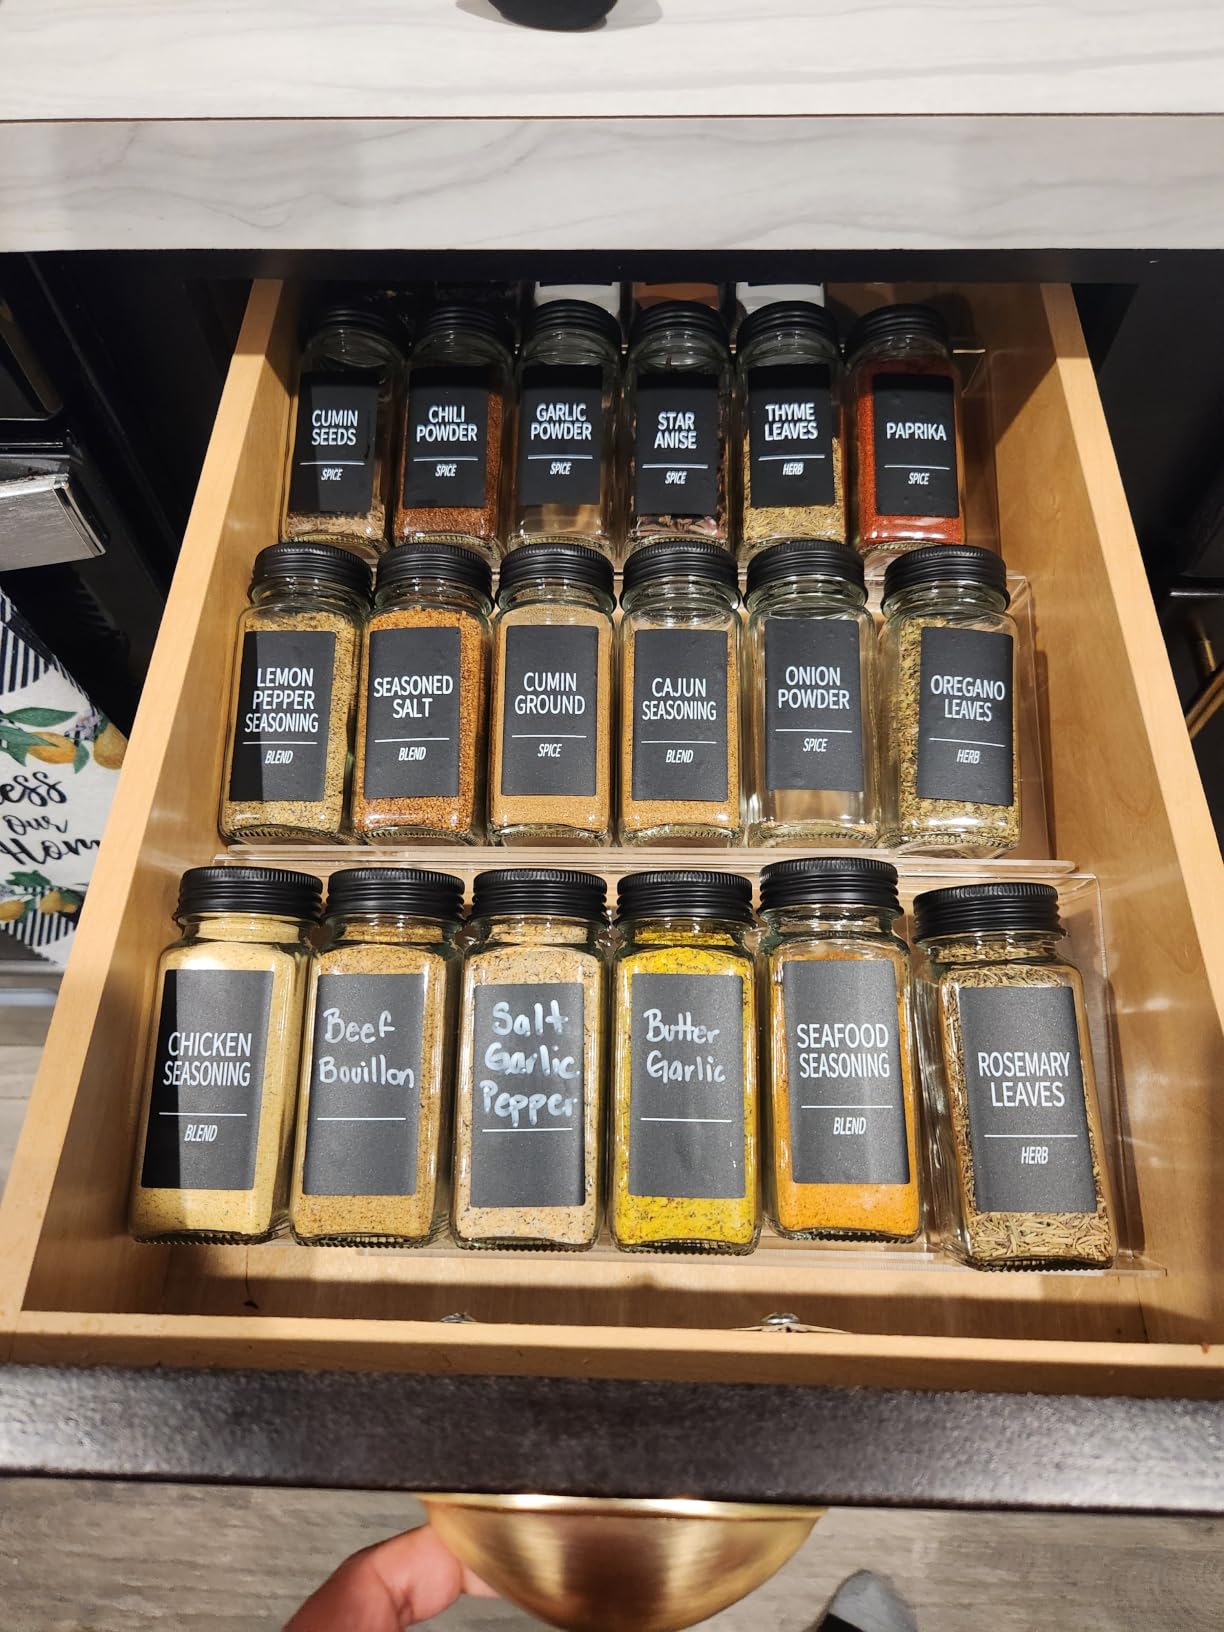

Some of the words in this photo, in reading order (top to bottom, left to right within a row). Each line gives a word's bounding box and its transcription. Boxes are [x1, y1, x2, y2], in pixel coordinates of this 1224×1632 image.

[312, 410, 358, 427] CUMIN
[429, 406, 465, 423] CHILI
[536, 404, 586, 421] GARLIC
[658, 412, 694, 430] STAR
[766, 403, 814, 421] THYME
[312, 428, 356, 446] SEEDS
[416, 424, 477, 442] POWDER
[531, 422, 592, 440] POWDER
[654, 431, 696, 449] ANISE
[765, 422, 818, 440] LEAVES
[887, 422, 946, 441] PAPRIKA
[321, 468, 342, 481] SPICE
[435, 464, 456, 477] SPICE
[550, 462, 571, 475] SPICE
[665, 472, 686, 484] SPICE
[783, 463, 803, 475] HERB
[908, 472, 929, 485] SPICE
[257, 668, 313, 687] LEMON
[524, 672, 576, 691] CUMIN
[786, 666, 840, 686] ONION
[374, 676, 453, 697] SEASONED
[652, 678, 706, 697] CAJUN
[931, 675, 1005, 700] OREGANO
[253, 691, 314, 710] PEPPER
[393, 698, 433, 718] SALT
[515, 696, 585, 715] GROUND
[778, 689, 849, 709] POWDER
[642, 700, 717, 720] SEASONING
[945, 702, 992, 722] LEAVES
[244, 714, 318, 733] SEASONING
[399, 747, 426, 760] BLEND
[538, 744, 562, 757] SPICE
[803, 738, 827, 752] SPICE
[265, 750, 293, 764] BLEND
[666, 750, 693, 763] BLEND
[957, 750, 980, 764] HERB
[0, 771, 67, 806] ess
[323, 1008, 395, 1044] Beef
[492, 1001, 568, 1037] Salt
[643, 1008, 720, 1043] Butter
[168, 1032, 252, 1056] CHICKEN
[797, 1024, 889, 1049] SEAFOOD
[485, 1043, 579, 1079] Garlic
[646, 1052, 725, 1083] Garlic
[800, 1053, 889, 1078] SEASONING
[978, 1052, 1070, 1078] ROSEMARY
[163, 1061, 250, 1086] SEASONING
[318, 1055, 414, 1088] Bouillon
[479, 1080, 578, 1127] Pepper
[991, 1082, 1065, 1107] LEAVES
[185, 1125, 217, 1142] BLEND
[833, 1117, 866, 1135] BLEND
[1021, 1147, 1048, 1164] HERB
